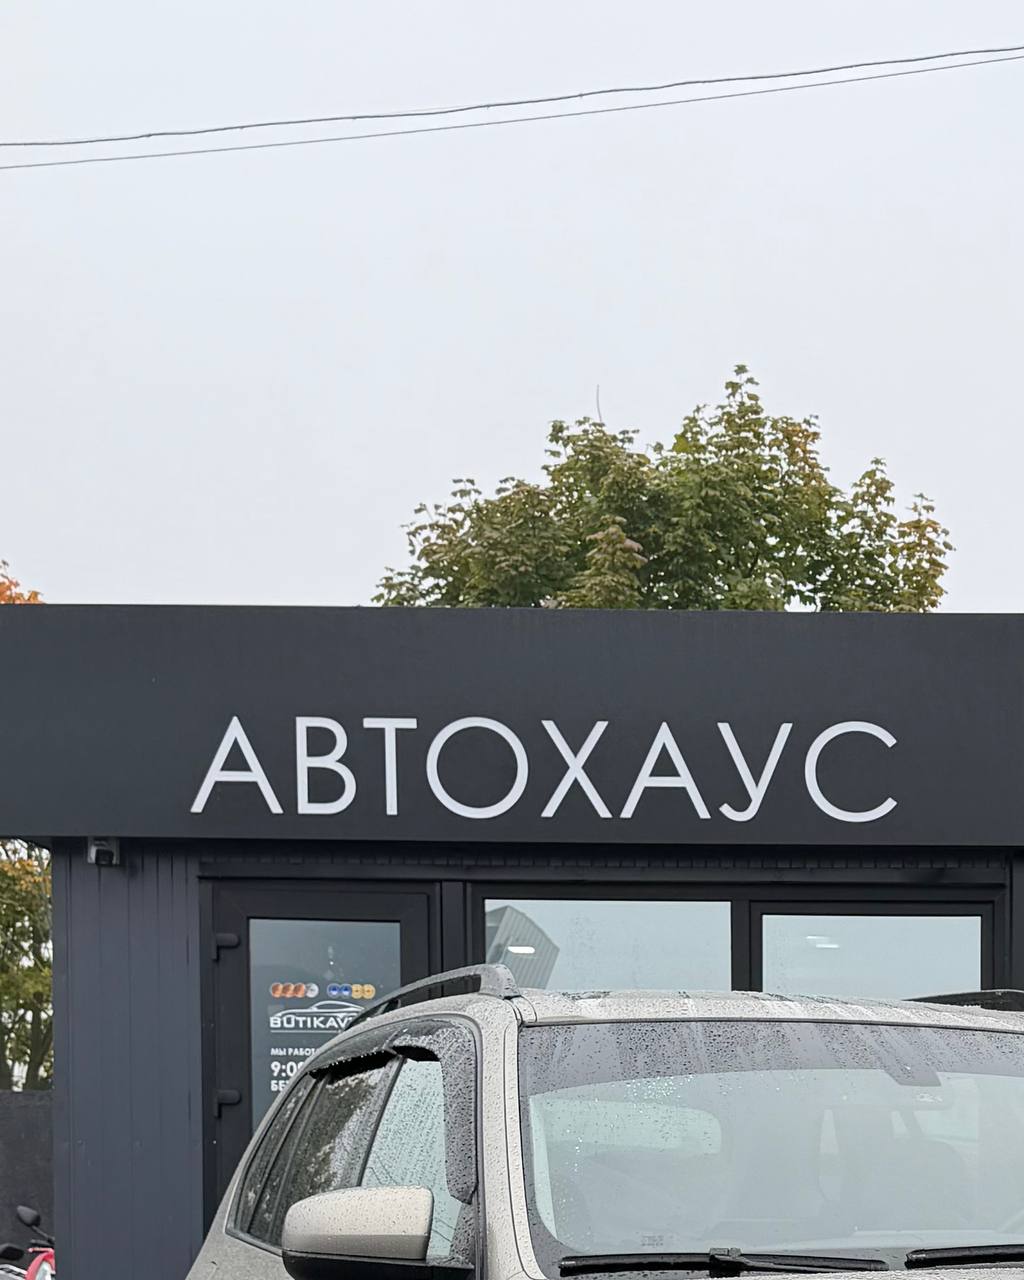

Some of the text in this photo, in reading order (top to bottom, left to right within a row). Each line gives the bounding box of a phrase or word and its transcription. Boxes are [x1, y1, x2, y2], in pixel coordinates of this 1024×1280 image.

[190, 715, 898, 822] АВТОХАУС
[269, 1016, 352, 1028] BUTIKAV
[270, 1048, 319, 1056] МЫ РАБОТ
[270, 1080, 289, 1092] БЕ
